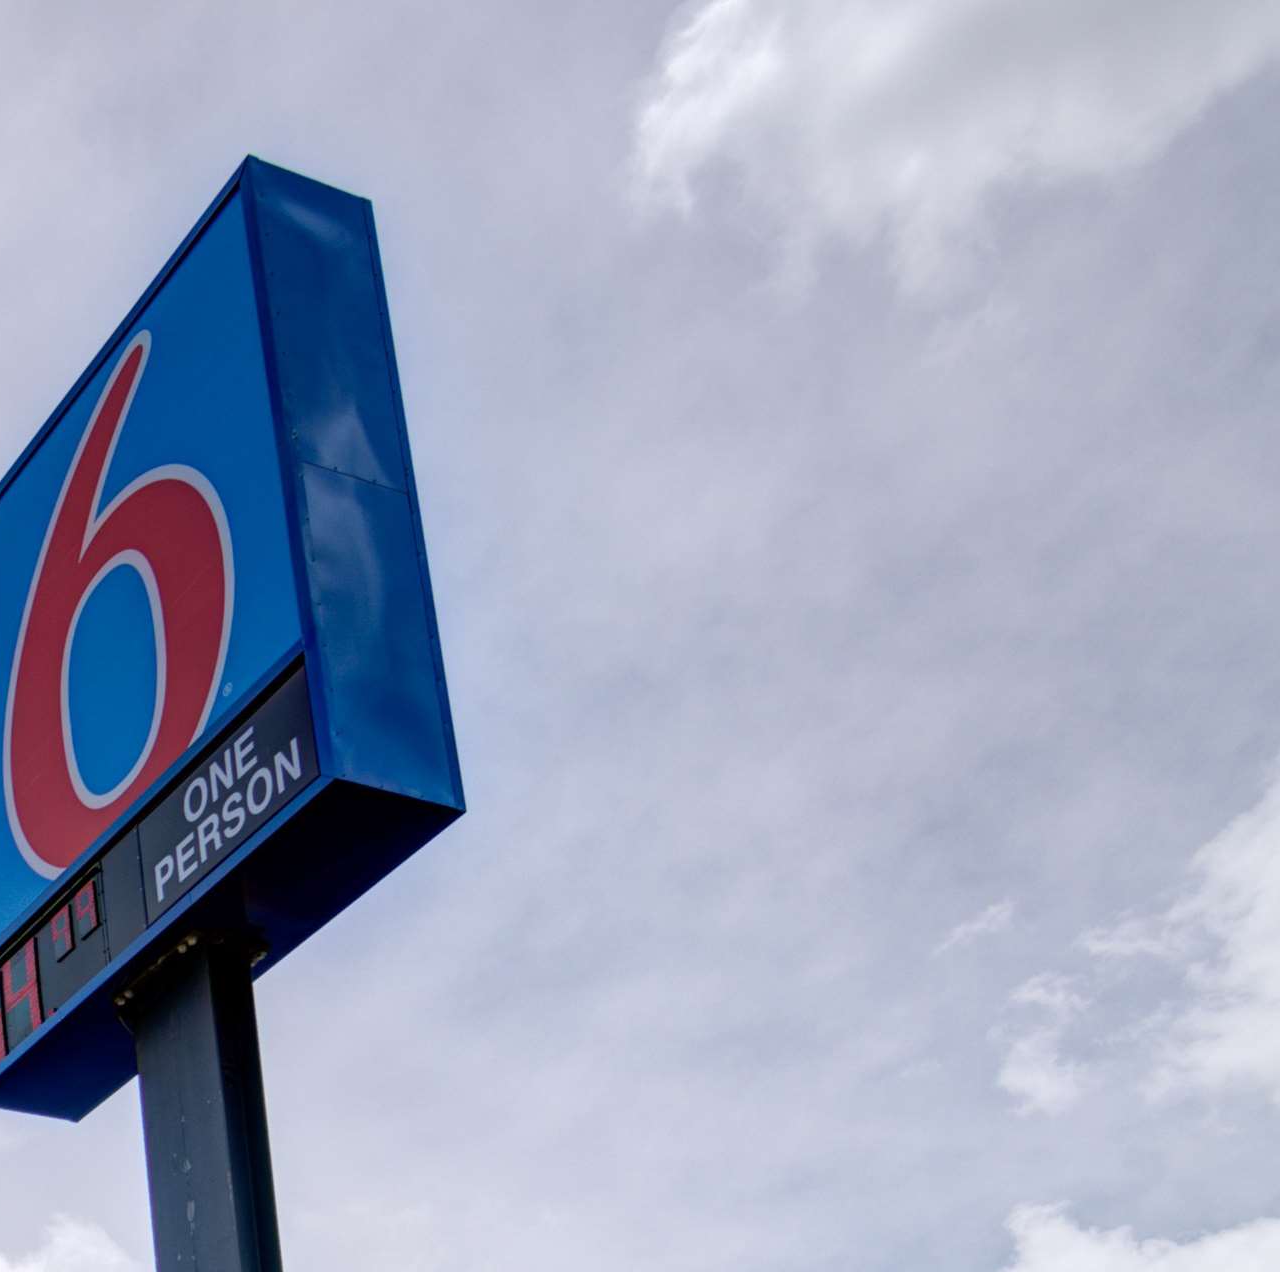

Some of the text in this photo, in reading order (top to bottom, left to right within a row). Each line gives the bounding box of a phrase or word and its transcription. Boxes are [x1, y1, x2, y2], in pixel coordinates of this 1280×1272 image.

[3, 329, 236, 881] 6
[154, 738, 302, 901] PERSON
[182, 726, 257, 824] ONE
